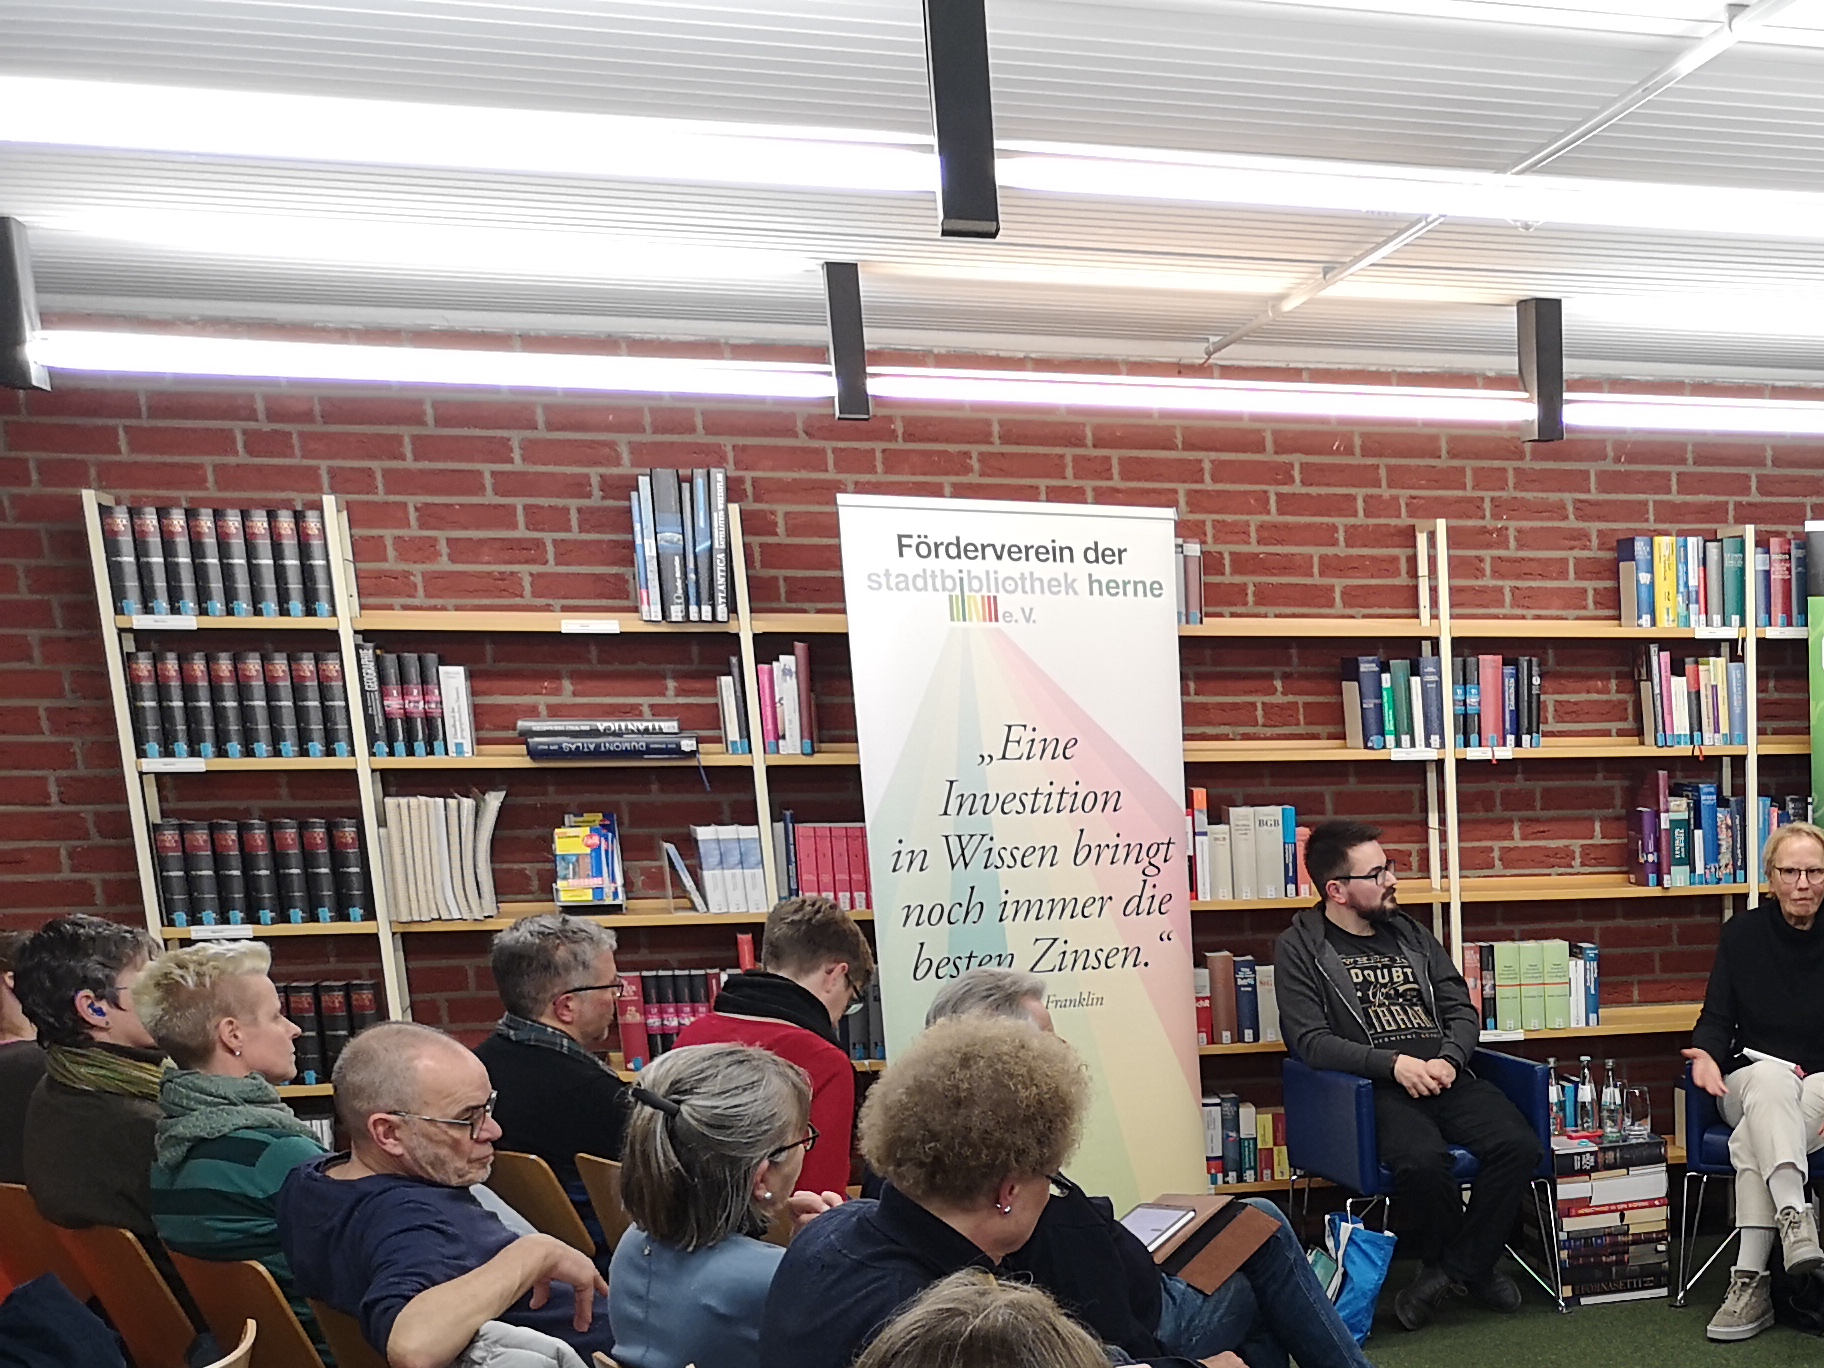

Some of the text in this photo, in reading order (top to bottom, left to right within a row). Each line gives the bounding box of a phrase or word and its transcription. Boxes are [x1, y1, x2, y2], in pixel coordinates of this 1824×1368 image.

[896, 534, 1128, 566] Förderverein der
[866, 567, 1164, 599] stadtbibliothek herne
[939, 779, 1123, 817] Investition
[890, 828, 1176, 877] in Wissen bringt
[901, 879, 1174, 929] noch immer die
[1349, 967, 1414, 984] DOUBT
[1045, 991, 1105, 1009] Franklin
